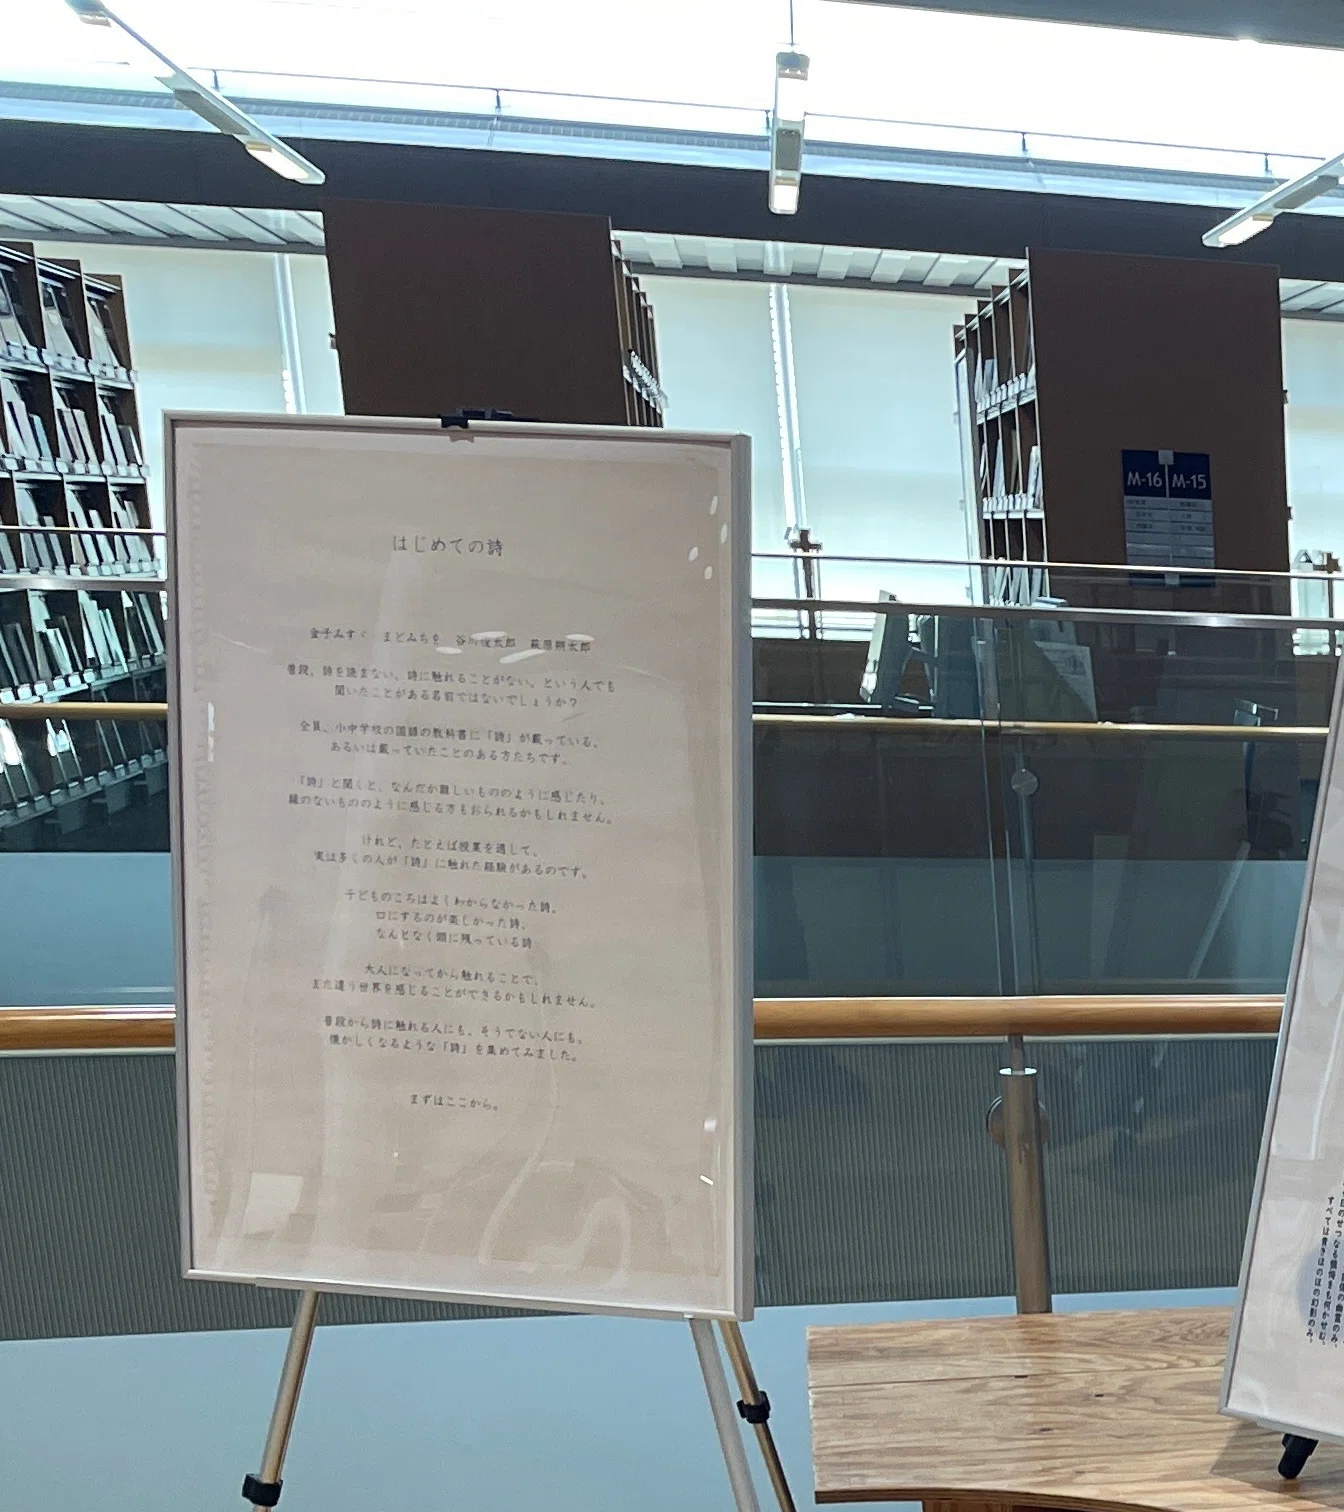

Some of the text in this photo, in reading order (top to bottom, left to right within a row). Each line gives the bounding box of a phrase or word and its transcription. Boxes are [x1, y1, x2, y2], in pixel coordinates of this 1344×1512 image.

[1127, 471, 1162, 487] M-16
[1172, 474, 1207, 489] M-15
[392, 535, 504, 557] はじめての詩
